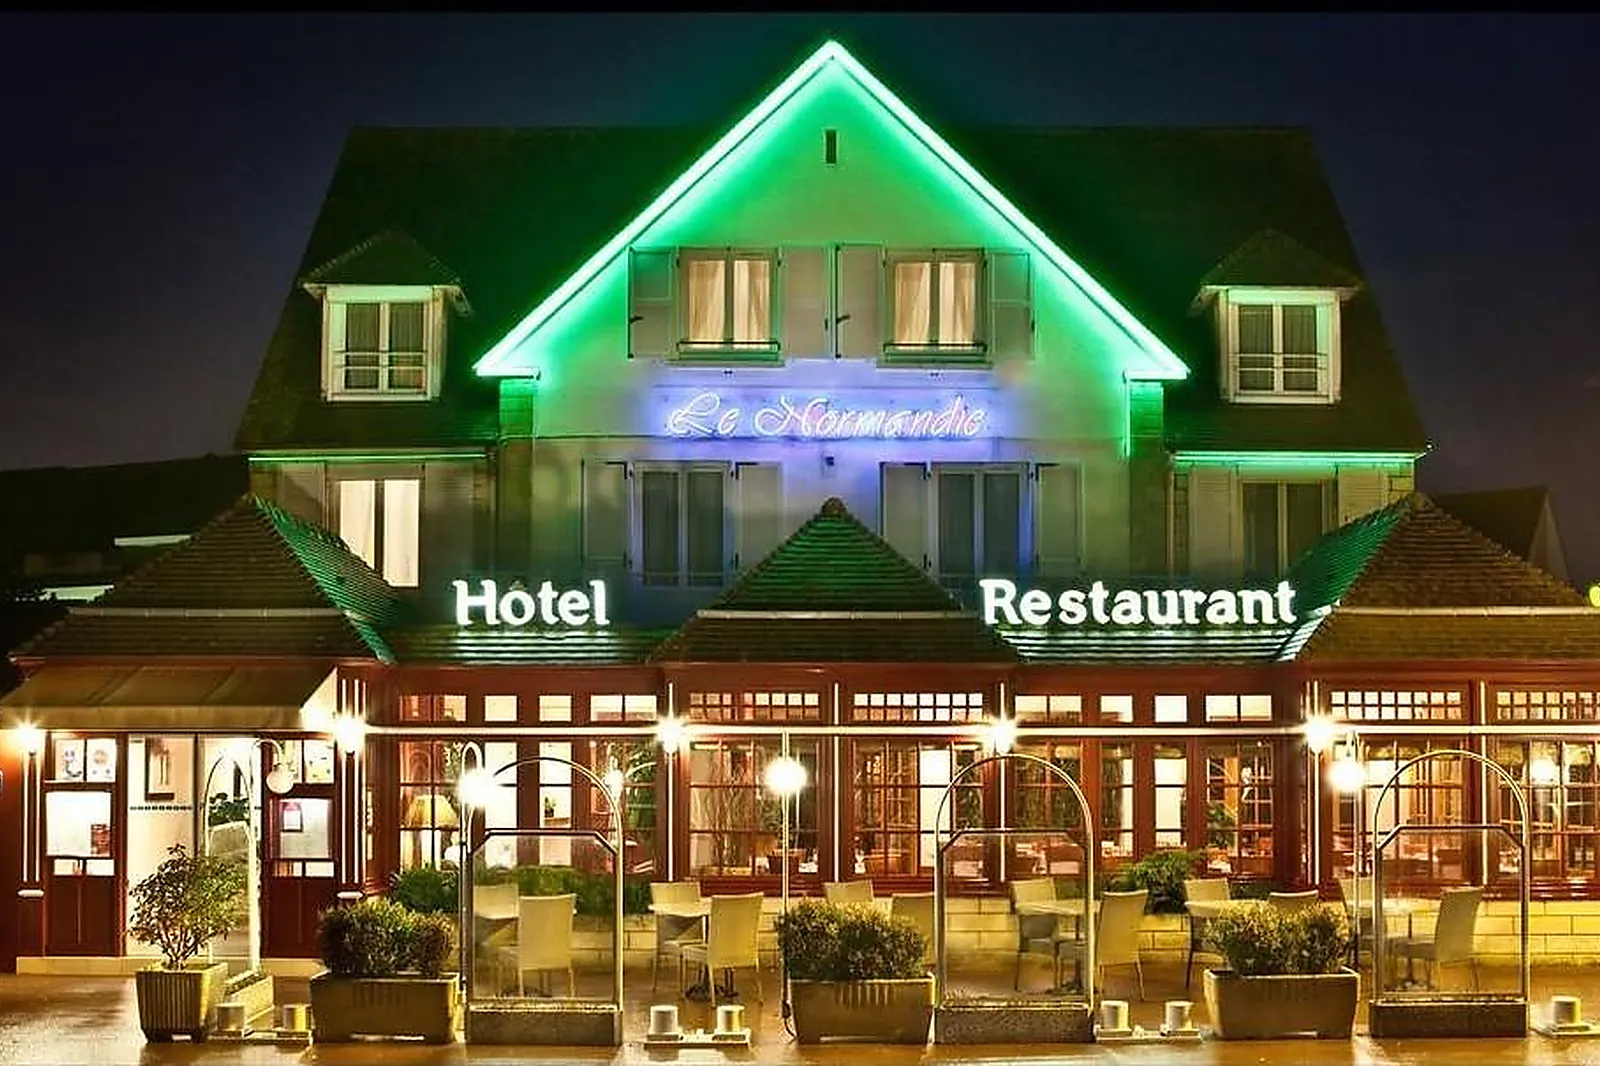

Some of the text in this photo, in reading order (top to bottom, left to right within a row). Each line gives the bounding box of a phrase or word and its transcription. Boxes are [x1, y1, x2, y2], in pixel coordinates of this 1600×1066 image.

[667, 393, 988, 437] Le Normandie
[979, 578, 1297, 625] Restaurant
